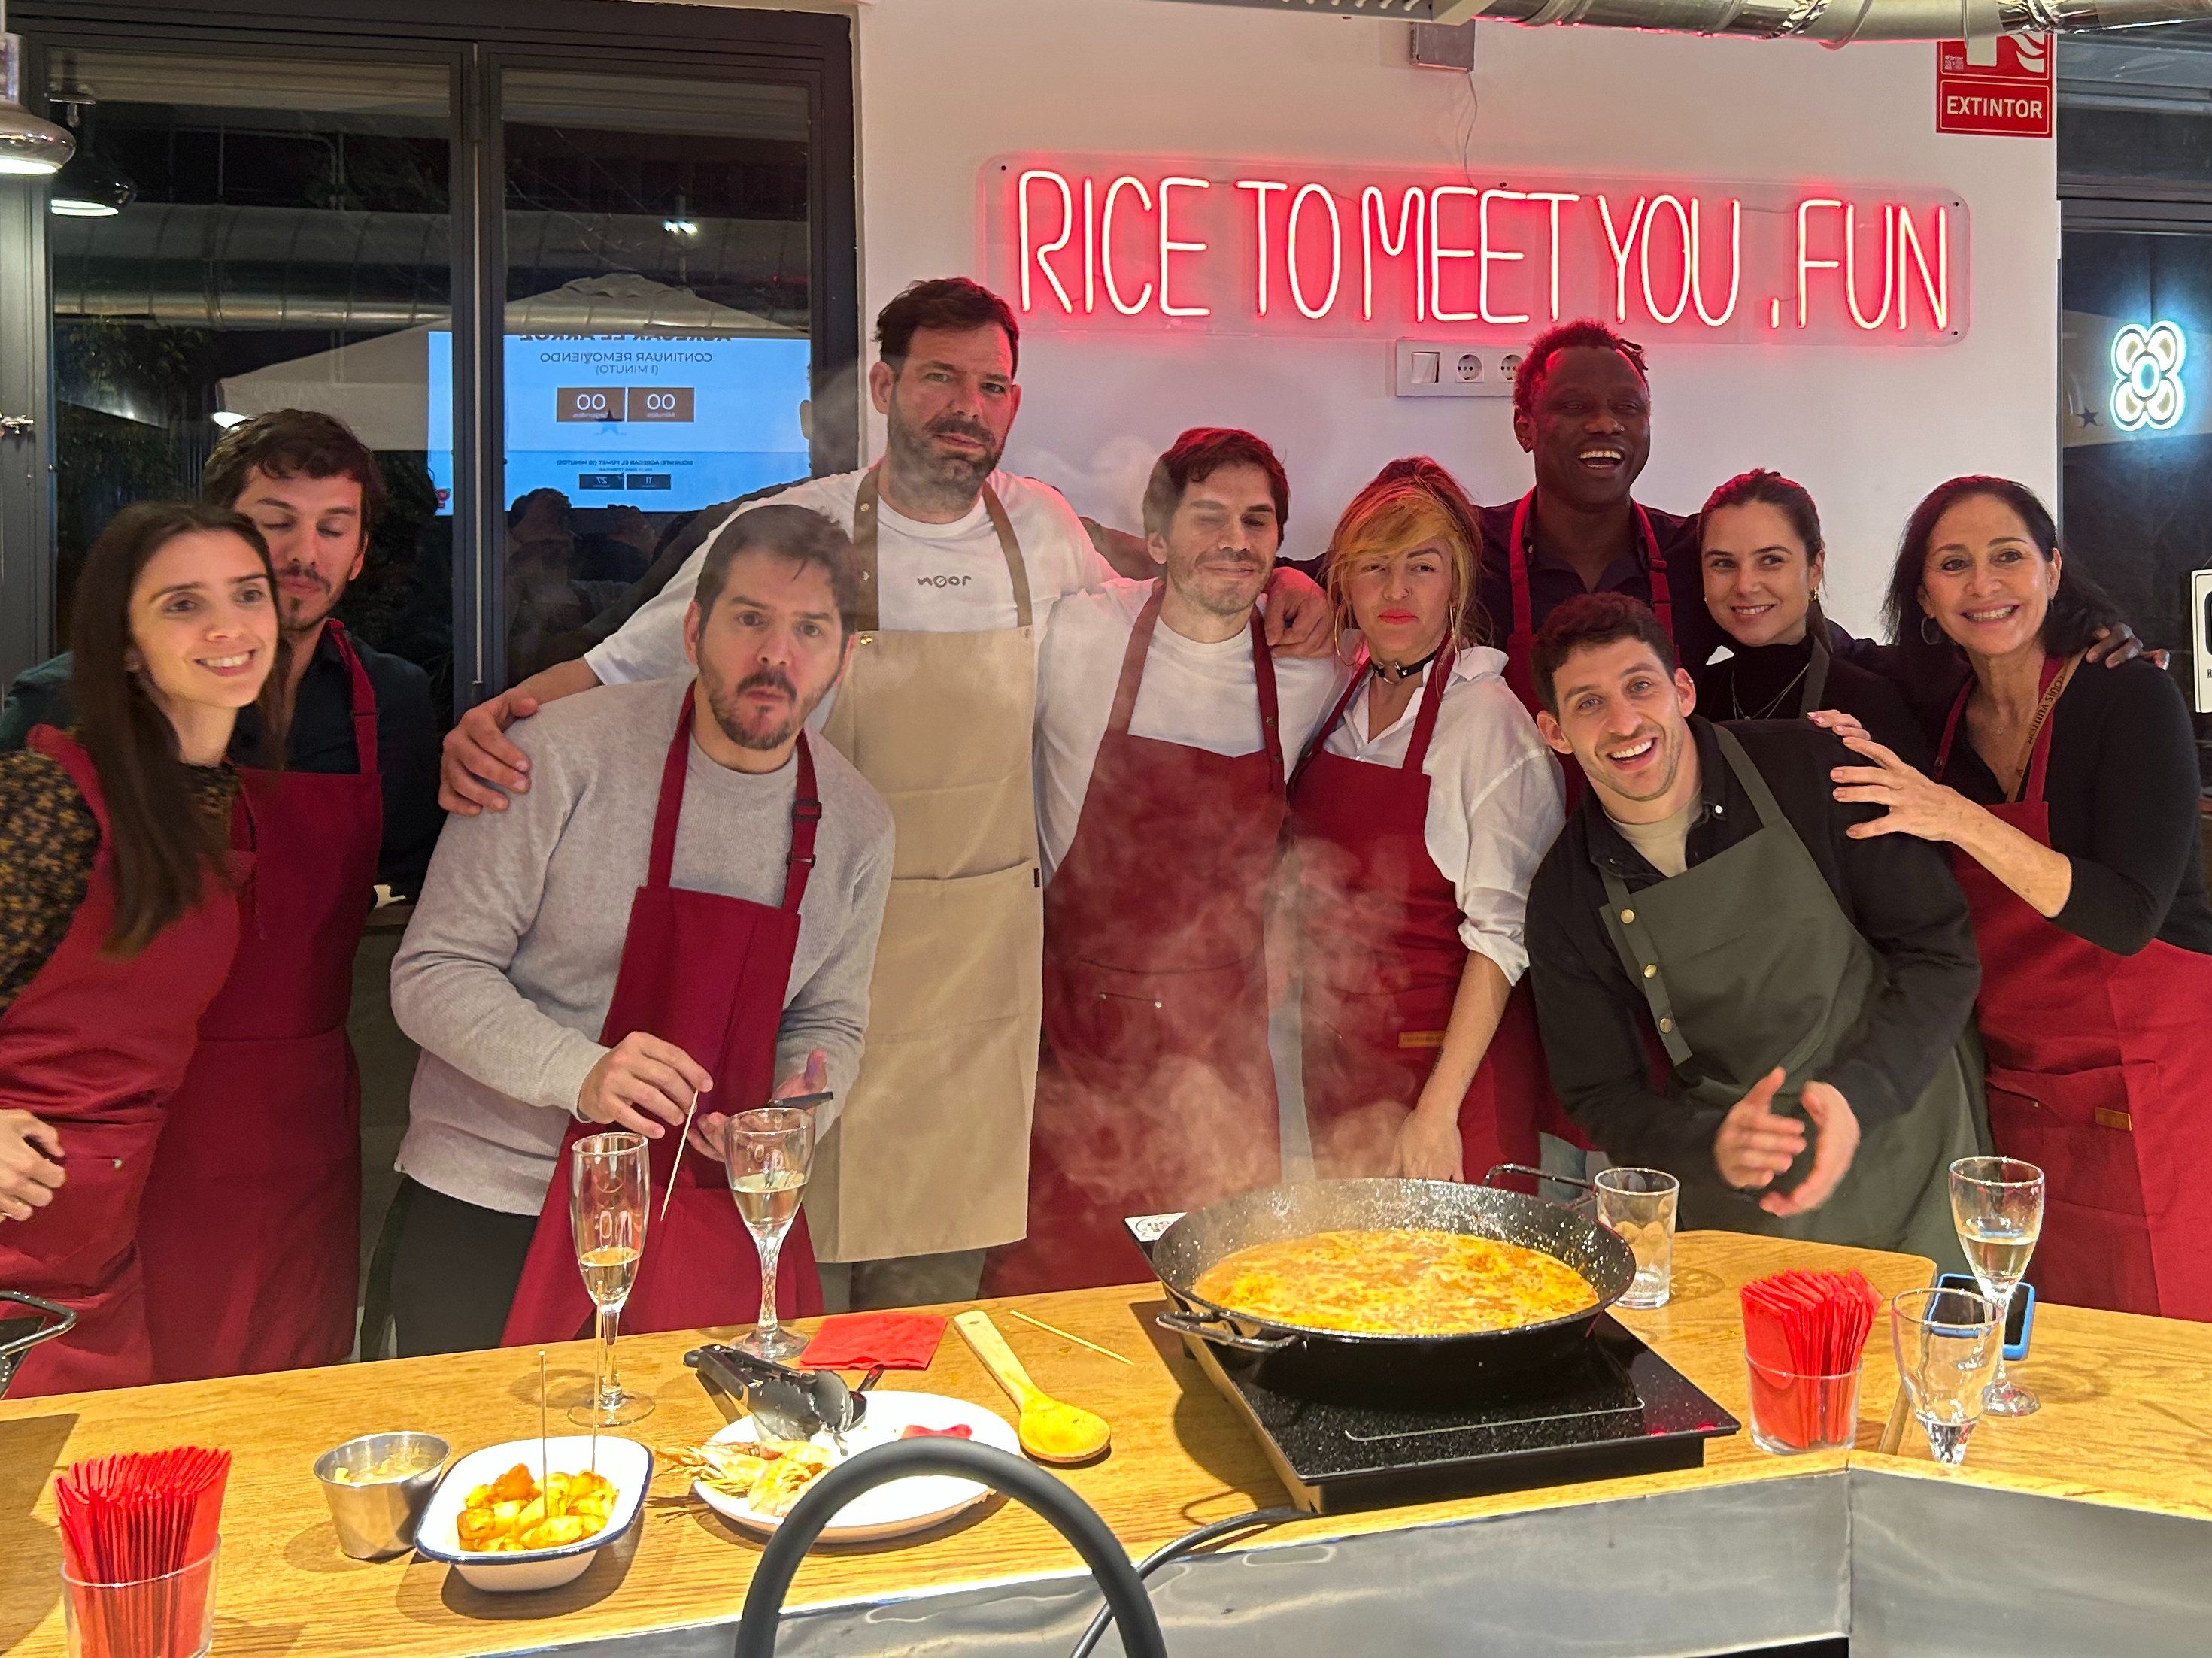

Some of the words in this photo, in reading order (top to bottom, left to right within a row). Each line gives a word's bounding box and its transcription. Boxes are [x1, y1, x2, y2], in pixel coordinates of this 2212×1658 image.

[1946, 95, 2043, 120] EXTINTOR
[1018, 170, 1211, 316] RICE
[1234, 181, 1340, 320] TO
[1361, 186, 1580, 324] MEET
[1597, 194, 1740, 326] YOU
